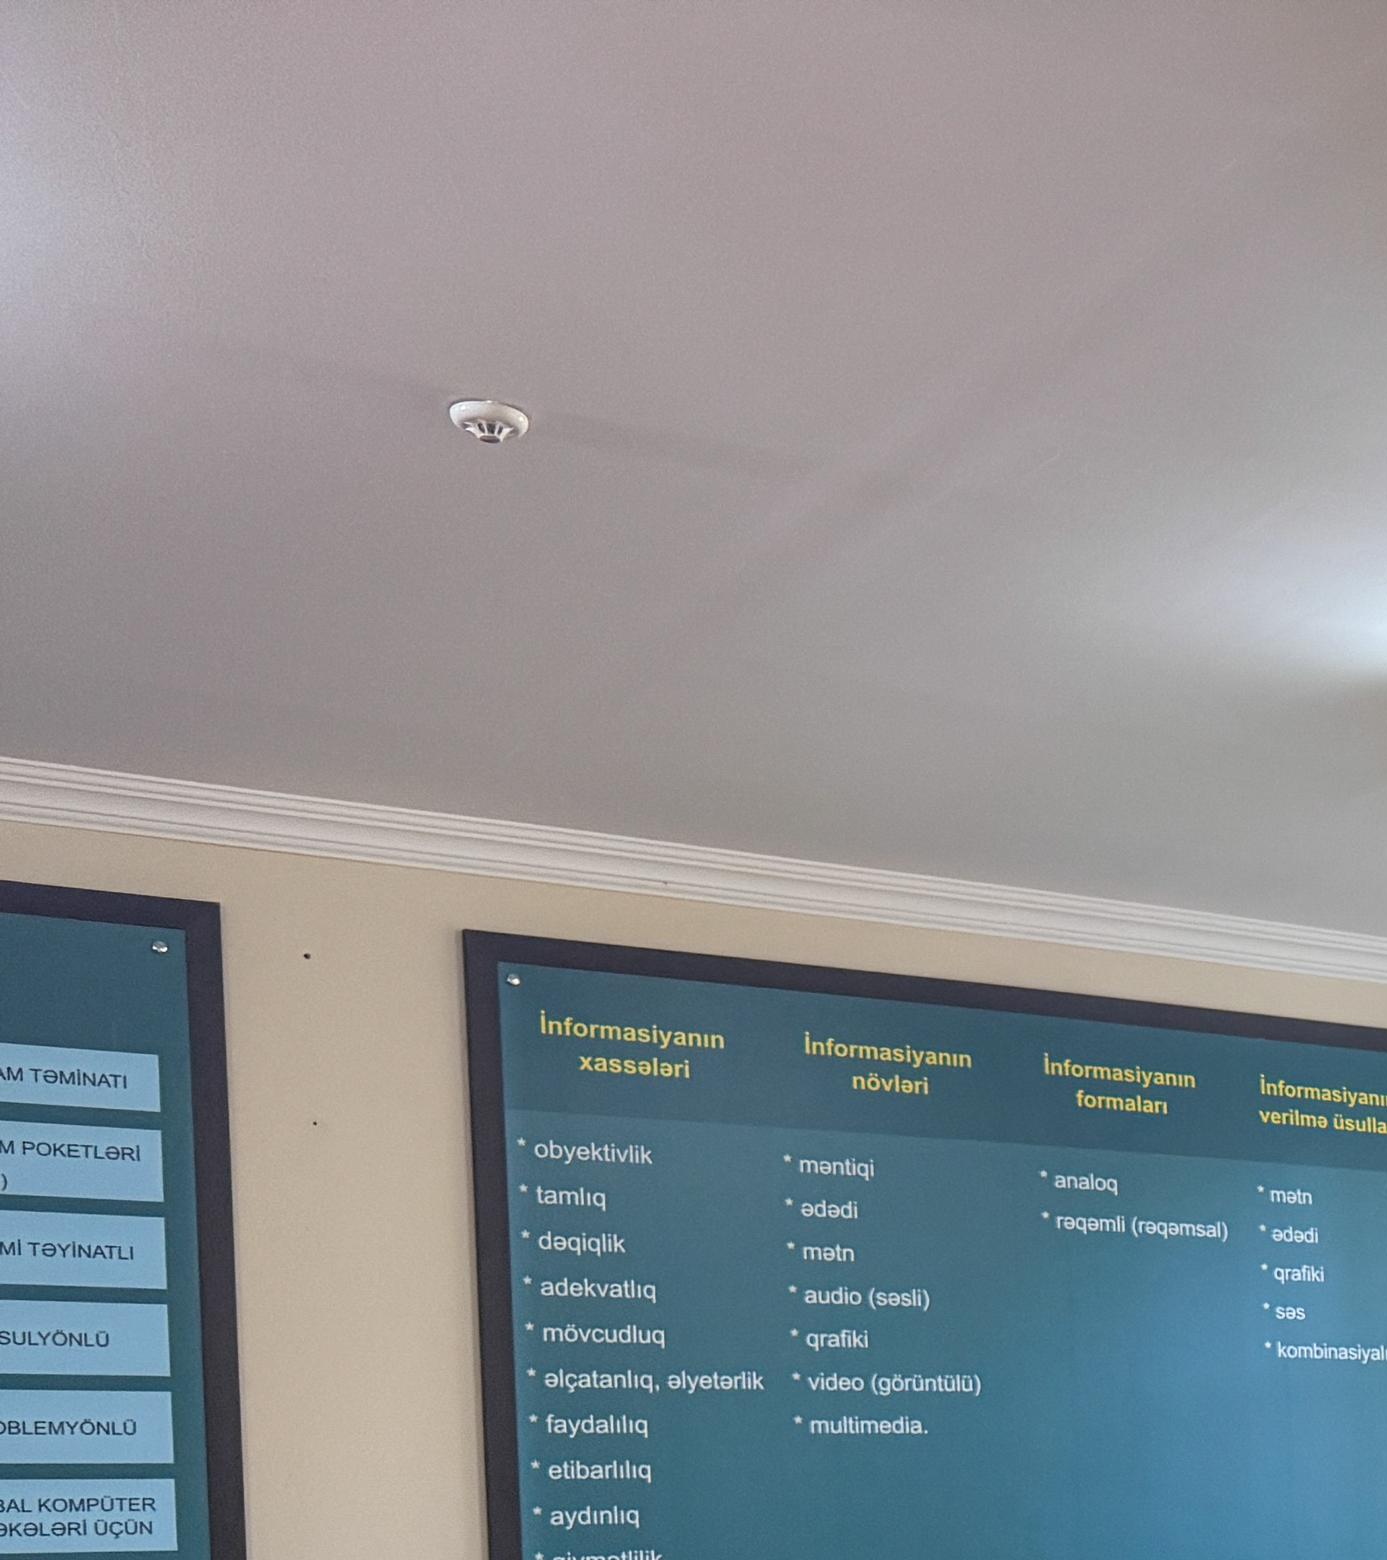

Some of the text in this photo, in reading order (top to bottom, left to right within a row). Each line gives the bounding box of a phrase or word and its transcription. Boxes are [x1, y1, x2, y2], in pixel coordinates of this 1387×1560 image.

[539, 1009, 725, 1049] İnformasiyanın
[804, 1032, 972, 1068] İnformasiyanın
[579, 1053, 691, 1079] xassələri
[1043, 1053, 1196, 1088] İnformasiyanın
[29, 1068, 128, 1089] TƏMİNATI
[852, 1073, 929, 1095] növləri
[1076, 1090, 1168, 1115] formaları
[1259, 1110, 1329, 1129] verilmə
[22, 1141, 141, 1162] POKETLƏRİ
[534, 1140, 653, 1165] obyektivlik
[799, 1157, 875, 1179] məntiqi
[1054, 1174, 1118, 1196] analoq
[536, 1185, 607, 1211] tamlıq
[1270, 1188, 1313, 1206] mətn
[801, 1200, 859, 1220] ədədi
[1056, 1215, 1229, 1242] rəqəmli (rəqəmsal)
[1272, 1227, 1319, 1245] ədədi
[28, 1240, 134, 1261] TƏYİNATLI
[538, 1231, 626, 1257] dəqiqlik
[802, 1244, 856, 1263] mətn
[1274, 1265, 1325, 1285] qrafiki
[540, 1277, 657, 1303] adekvatlıq
[804, 1287, 931, 1311] audio (səsli)
[1275, 1305, 1306, 1321] səs
[542, 1324, 666, 1348] mövcudluq
[806, 1330, 869, 1351] qrafiki
[544, 1370, 764, 1395] əlçatanlıq, əlyetərlik
[808, 1373, 982, 1397] video (görüntülü)
[545, 1414, 649, 1439] faydalılıq
[810, 1416, 929, 1435] multimedia.
[548, 1460, 652, 1484] etibarlılıq
[38, 1496, 156, 1513] KOMPÜTER
[94, 1519, 153, 1539] ÜÇÜN
[550, 1506, 640, 1530] aydınlıq
